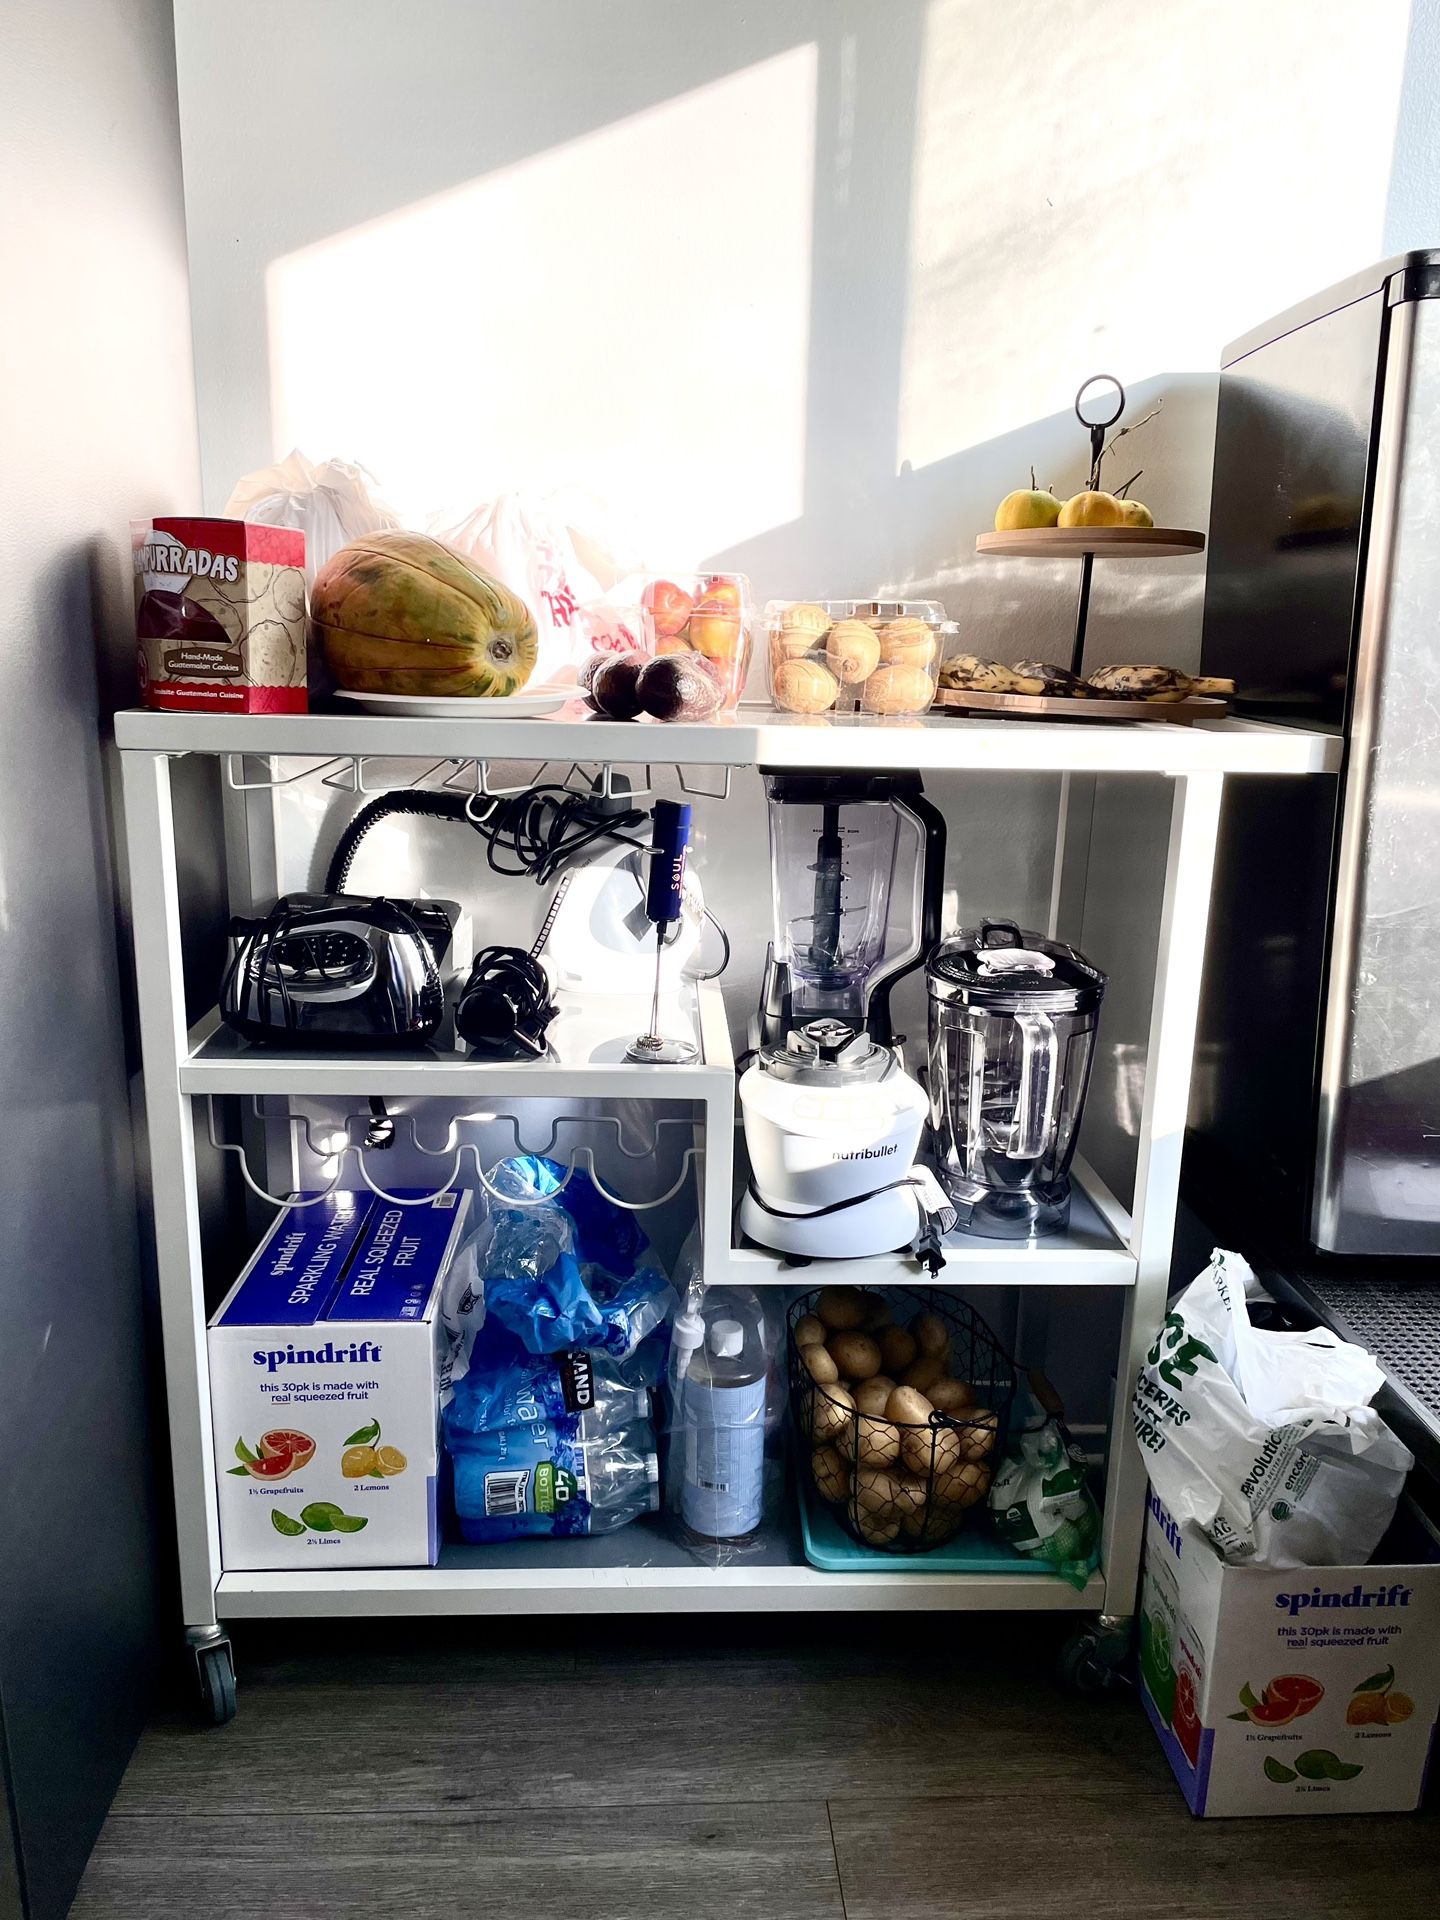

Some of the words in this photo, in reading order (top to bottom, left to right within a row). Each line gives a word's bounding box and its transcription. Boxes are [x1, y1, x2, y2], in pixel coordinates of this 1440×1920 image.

[181, 652, 224, 662] Hand-Made
[168, 660, 210, 670] Guatemalan
[212, 662, 240, 672] Cookies
[176, 689, 218, 698] Guatemalan
[832, 1144, 898, 1160] nutribullet
[270, 1232, 306, 1276] spindrift
[350, 1266, 381, 1296] REAL
[367, 1210, 403, 1265] SQUEEZED
[393, 1236, 421, 1266] FRUIT
[288, 1244, 337, 1304] SPARKLING
[253, 1341, 382, 1372] spindrift
[260, 1383, 279, 1392] this
[282, 1382, 310, 1393] 30pk
[312, 1382, 321, 1391] is
[323, 1381, 354, 1390] made
[356, 1380, 379, 1390] with
[271, 1393, 291, 1402] real
[293, 1391, 345, 1403] squeezed
[347, 1391, 369, 1400] fruit
[260, 1486, 304, 1496] Grapefruits
[554, 1470, 570, 1502] 40
[1275, 1584, 1412, 1617] spindrift
[1278, 1627, 1297, 1637] this
[1300, 1626, 1330, 1637] 30pk
[1332, 1626, 1341, 1636] is
[1343, 1626, 1376, 1636] made
[1378, 1625, 1402, 1635] with
[1287, 1637, 1308, 1647] real
[1310, 1636, 1364, 1648] squeezed
[1366, 1636, 1389, 1645] fruit
[1257, 1734, 1303, 1742] Grapefruits
[1361, 1731, 1392, 1739] Lemons
[1307, 1785, 1331, 1793] Limes
